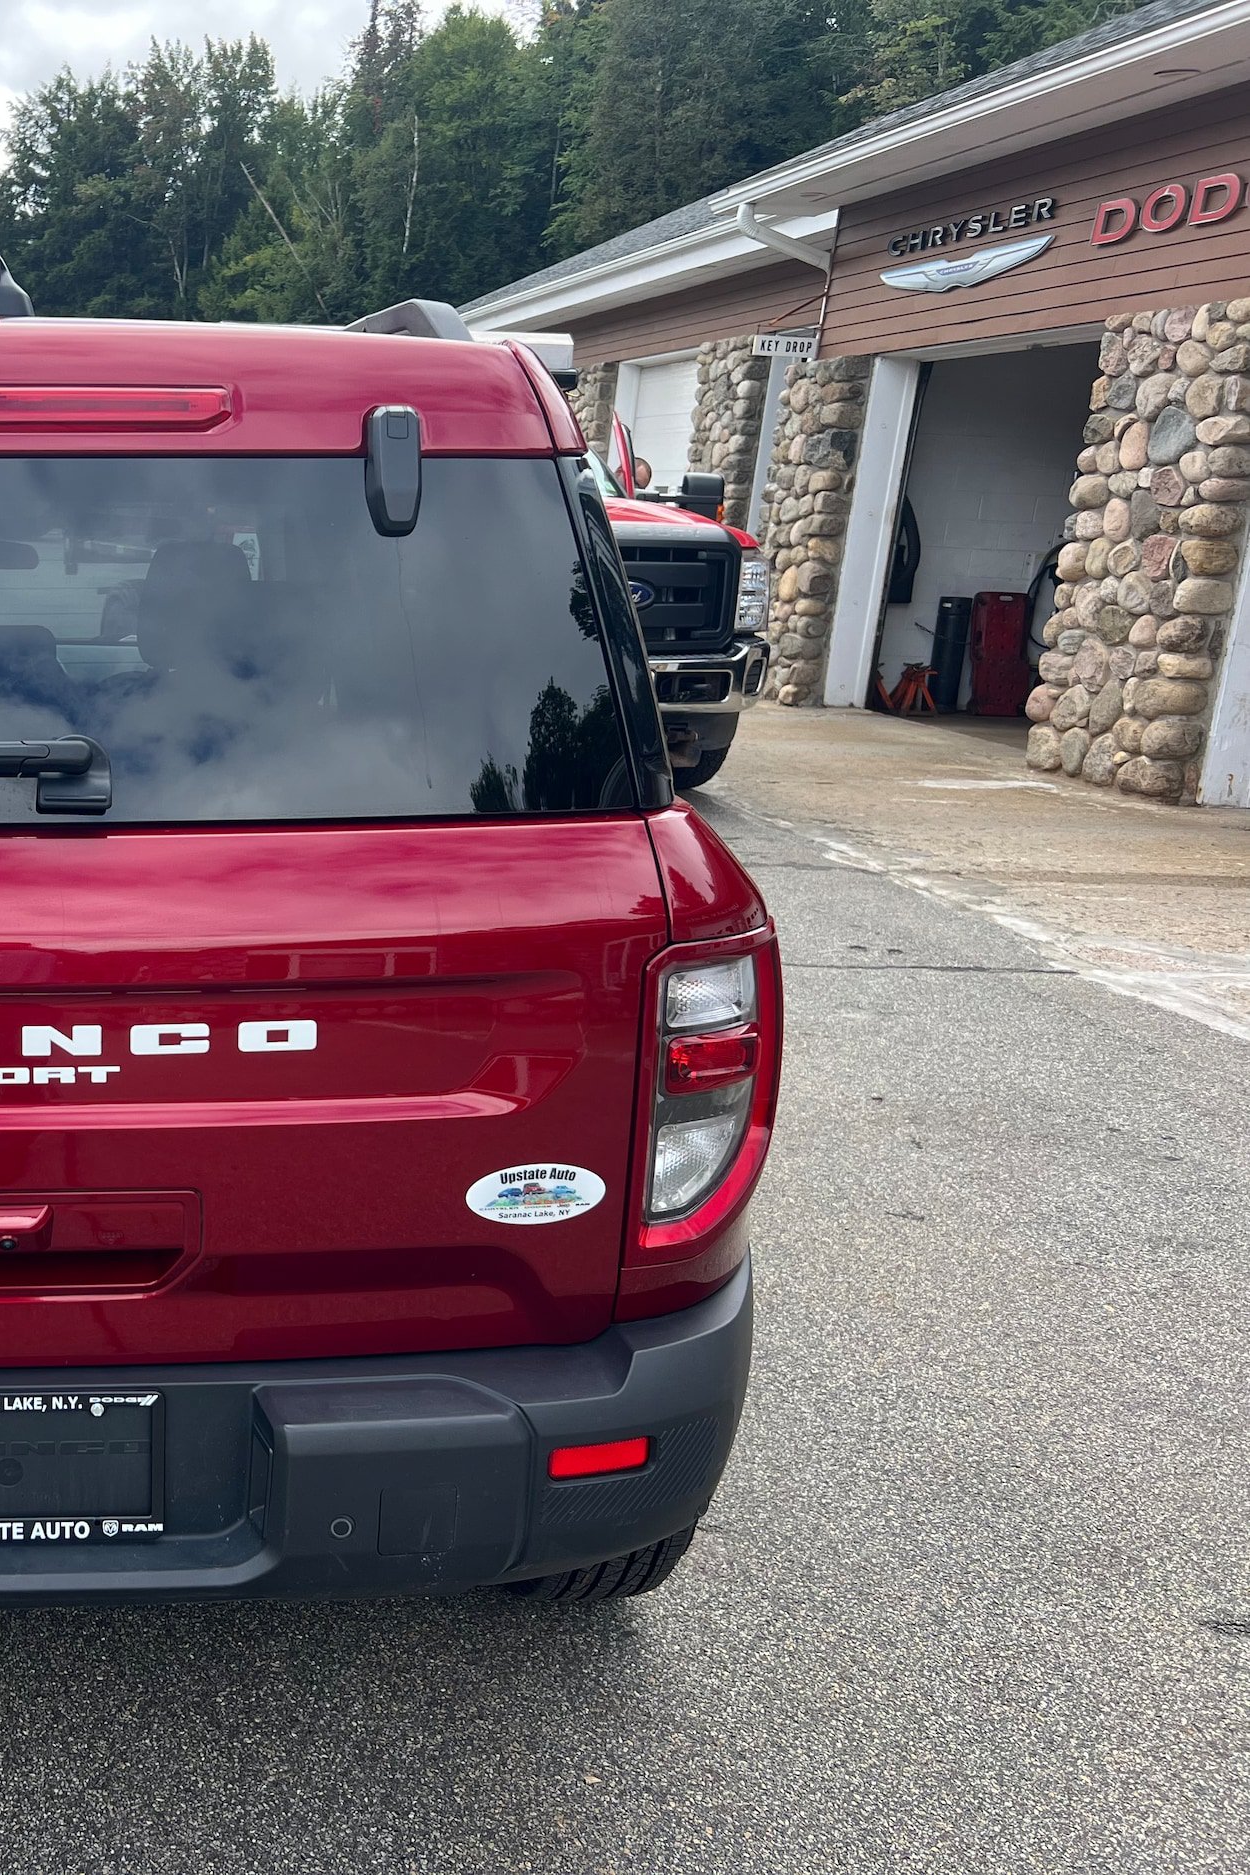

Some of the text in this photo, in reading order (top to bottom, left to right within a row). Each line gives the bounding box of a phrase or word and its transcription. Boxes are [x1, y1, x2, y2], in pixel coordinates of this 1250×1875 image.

[1090, 172, 1250, 247] DOD
[887, 197, 1055, 257] CHRYSLER
[760, 339, 813, 353] KEY DROP
[499, 1167, 577, 1185] Upstate Auto
[534, 1210, 556, 1218] Lake,
[3, 1396, 48, 1413] LAKE,
[51, 1396, 83, 1410] N.Y.
[30, 1521, 91, 1540] AUTO
[121, 1523, 164, 1532] RAM
